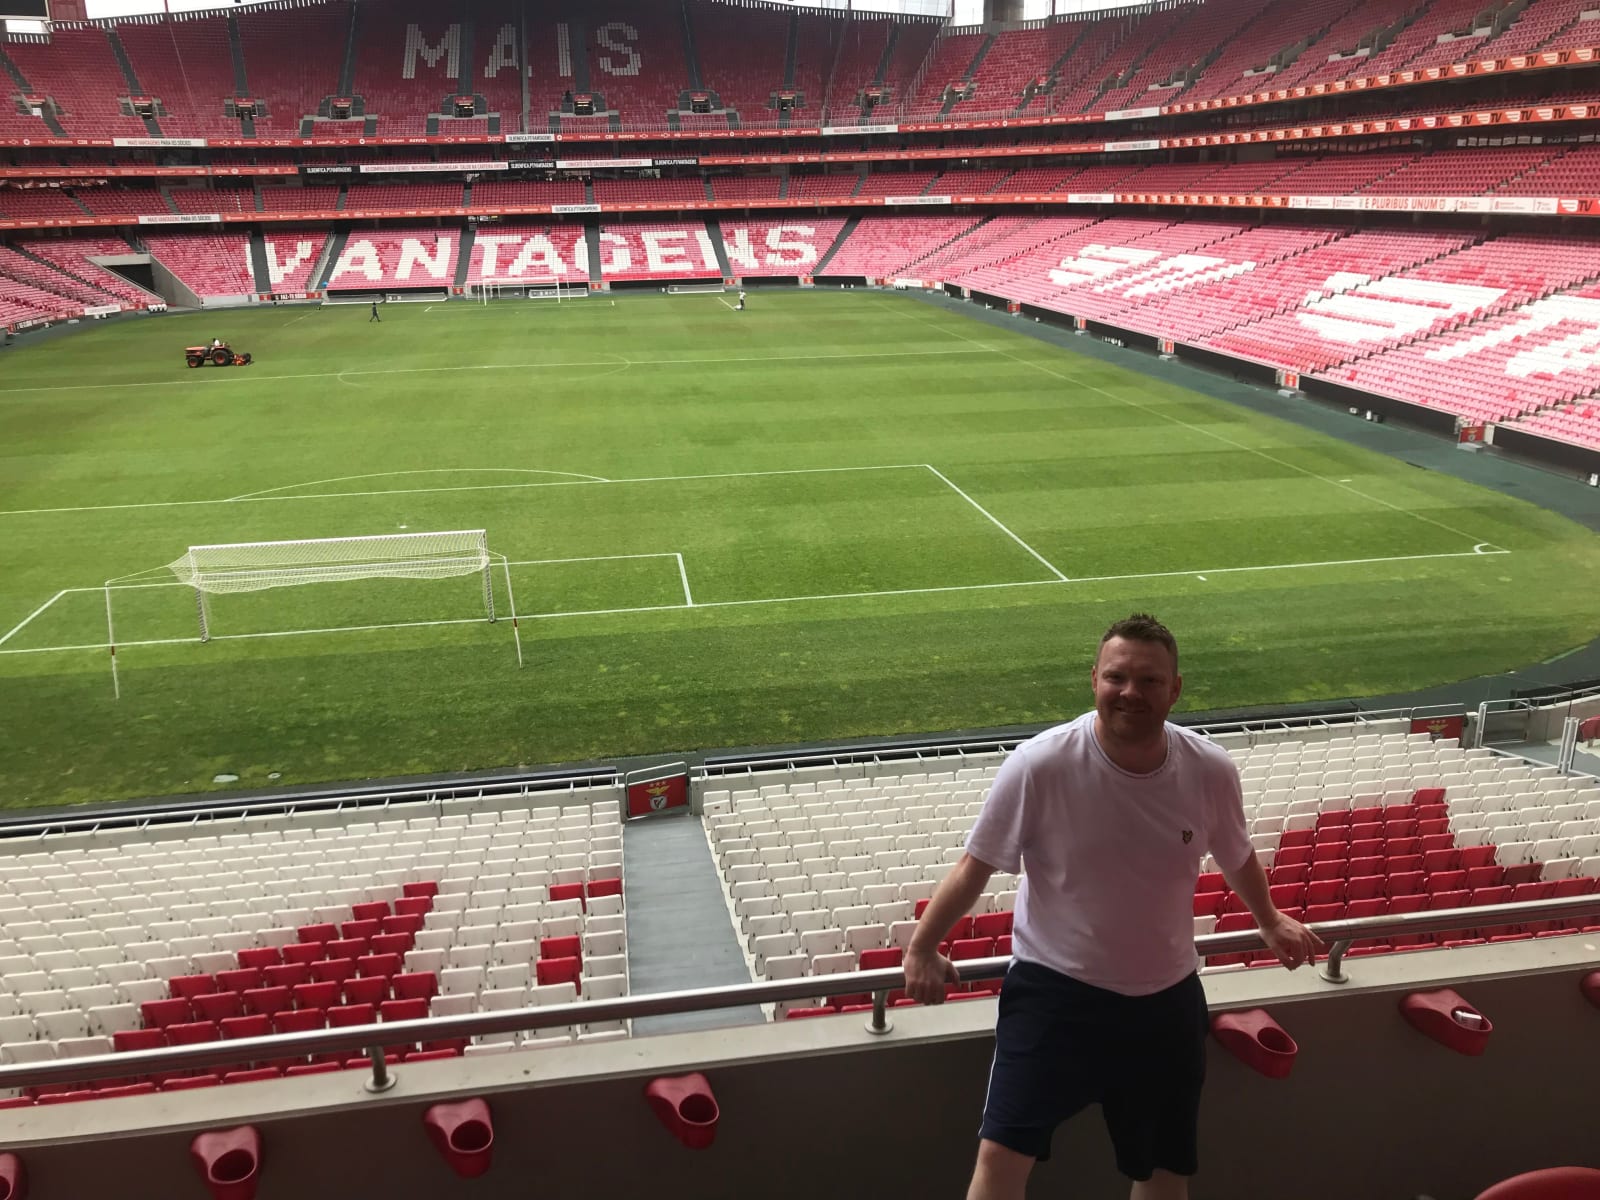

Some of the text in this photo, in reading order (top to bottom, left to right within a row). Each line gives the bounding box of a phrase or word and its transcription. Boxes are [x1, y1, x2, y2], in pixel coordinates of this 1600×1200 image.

[402, 22, 642, 79] MAIS
[1372, 198, 1408, 209] PLURIBUS
[1411, 198, 1438, 209] UNUM
[245, 225, 818, 284] VANTAGENS
